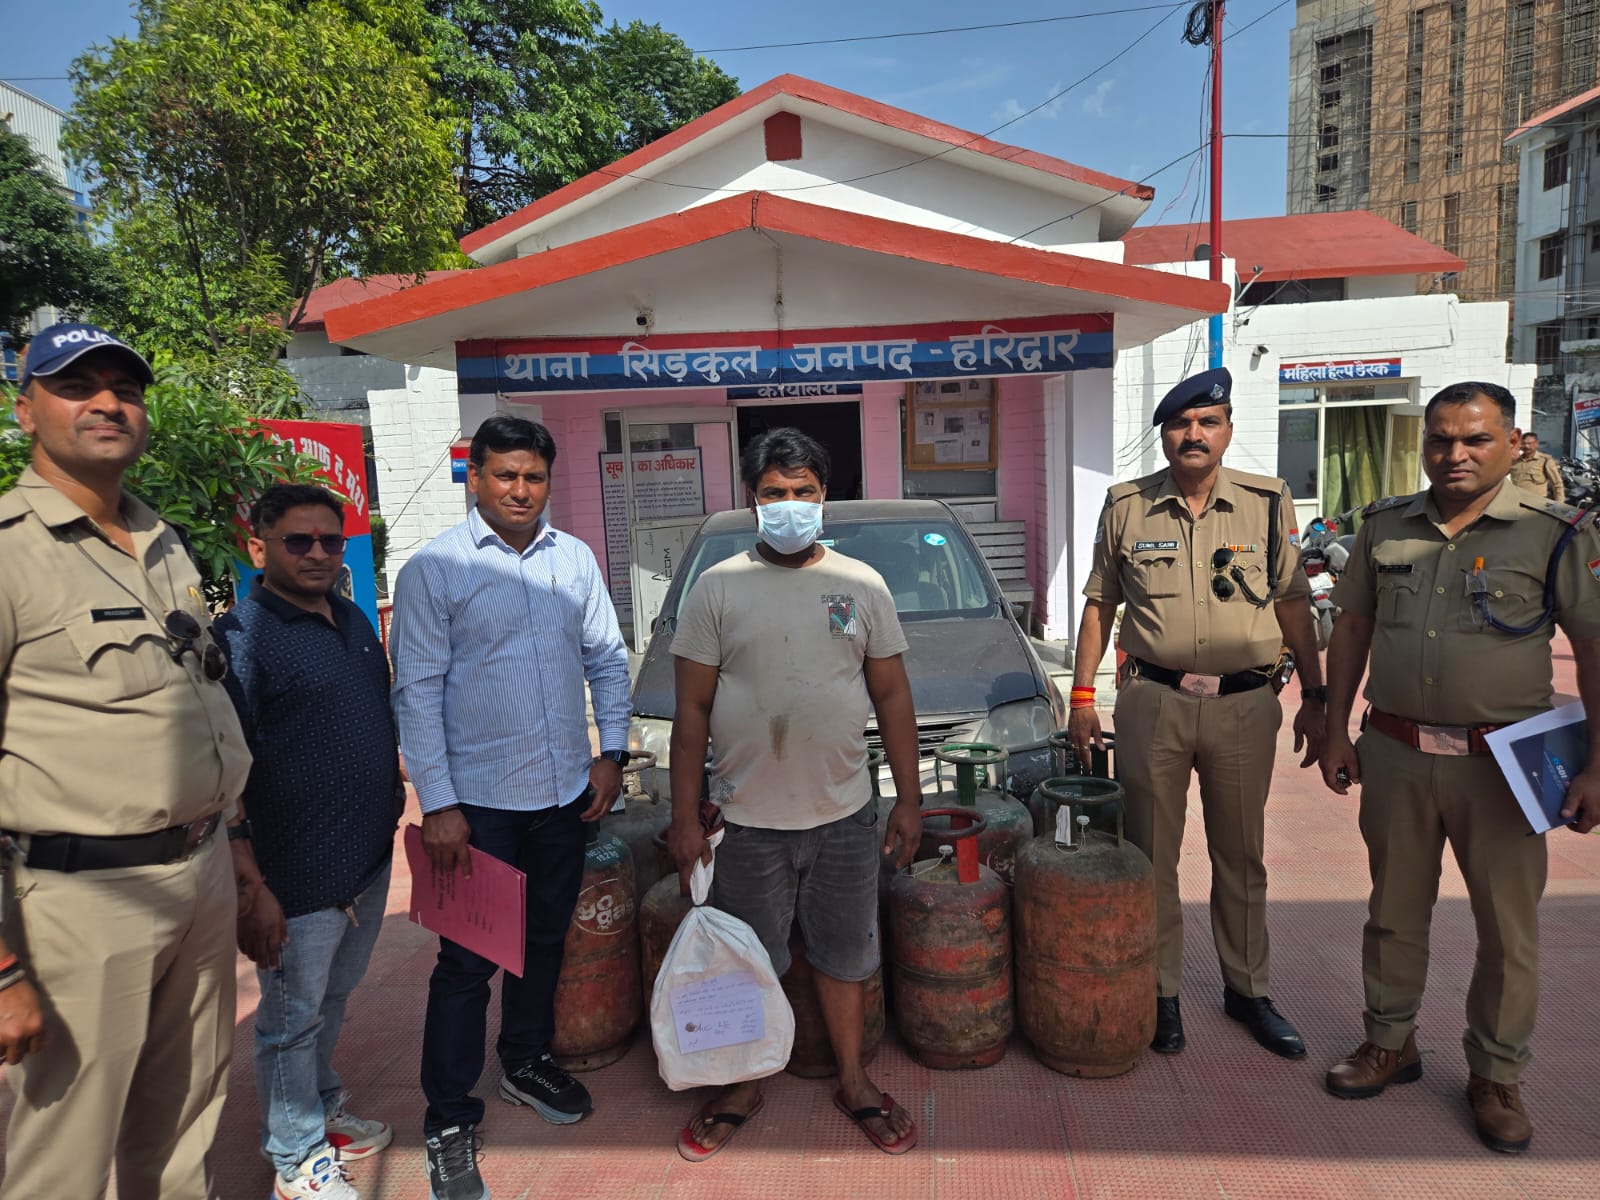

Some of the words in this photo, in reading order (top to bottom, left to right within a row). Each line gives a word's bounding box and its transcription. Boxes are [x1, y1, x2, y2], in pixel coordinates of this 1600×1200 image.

[503, 351, 591, 382] थाना
[790, 338, 918, 376] जनपद
[949, 324, 1082, 372] हरिद्वार
[1283, 363, 1326, 383] महिला
[637, 460, 651, 472] का
[654, 454, 696, 472] अधिकार
